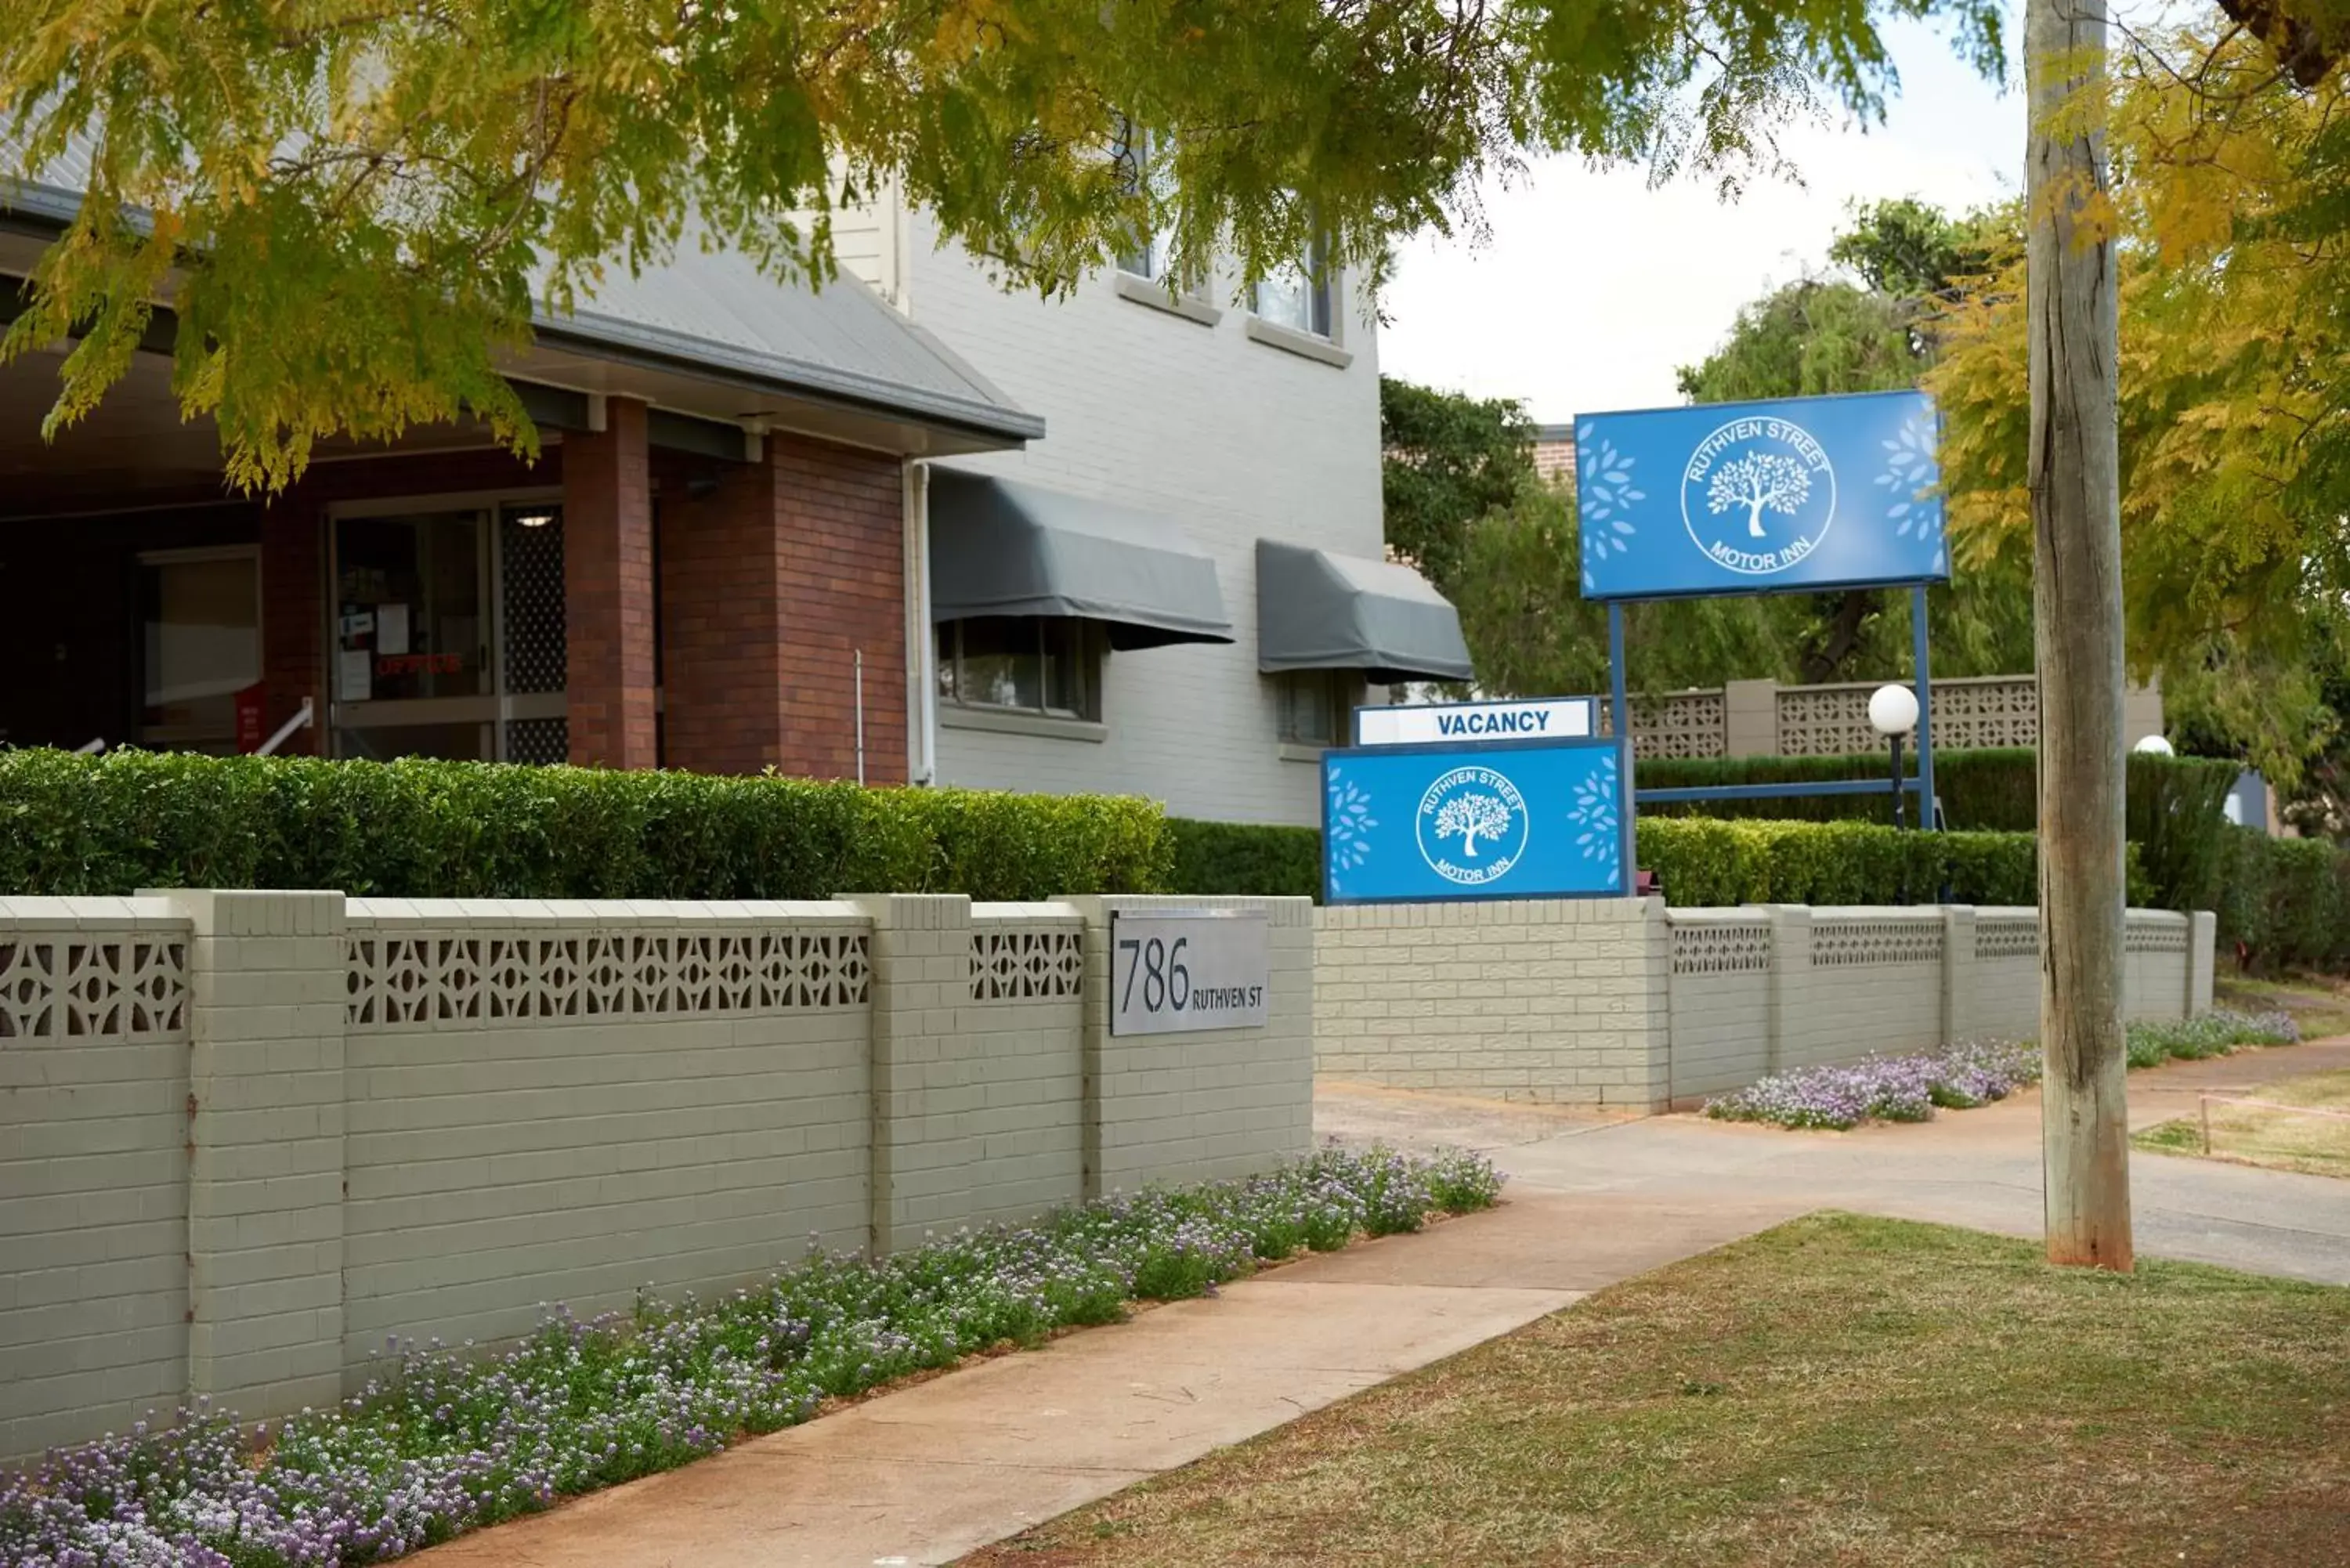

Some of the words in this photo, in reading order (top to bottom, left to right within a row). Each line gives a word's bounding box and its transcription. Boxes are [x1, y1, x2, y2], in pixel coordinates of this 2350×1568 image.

[1689, 421, 1762, 482] RUTHVEN
[1766, 421, 1829, 474] STREET
[1711, 539, 1777, 571] MOTOR
[1780, 536, 1811, 564] INN
[1438, 711, 1549, 735] VACANCY
[1423, 771, 1476, 815] RUTHVEN
[1479, 771, 1523, 811] STREET
[1436, 858, 1484, 881] MOTOR
[1487, 856, 1510, 877] INN
[1119, 937, 1189, 1013] 786
[1193, 988, 1246, 1010] RUTHVEN
[1248, 987, 1263, 1007] ST
